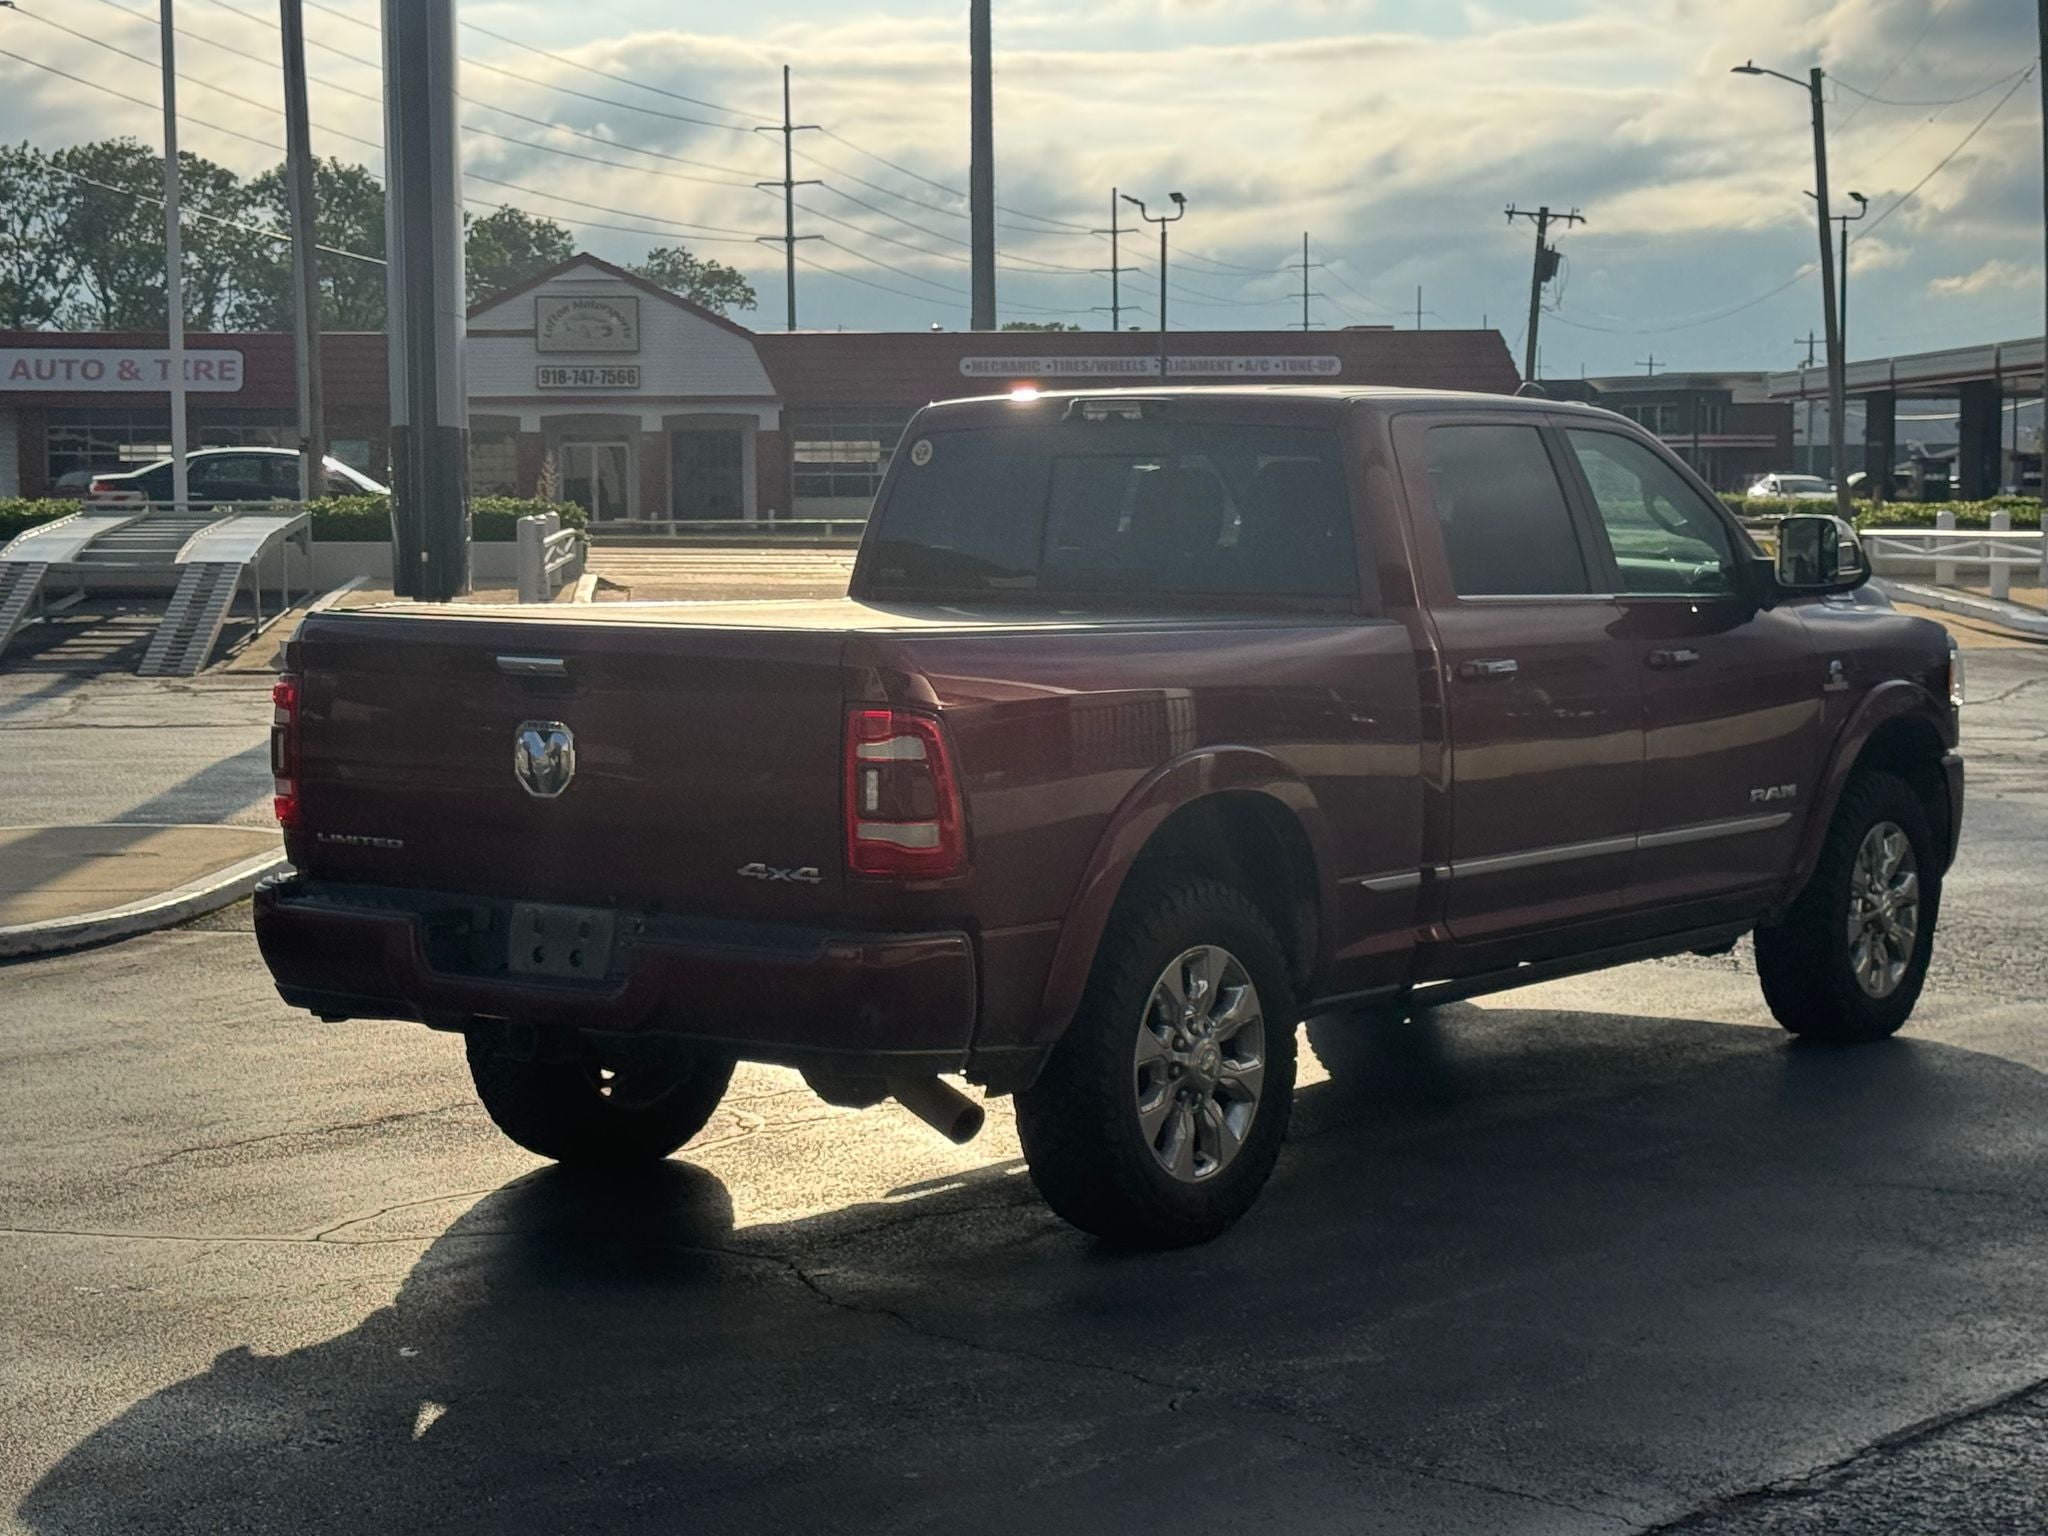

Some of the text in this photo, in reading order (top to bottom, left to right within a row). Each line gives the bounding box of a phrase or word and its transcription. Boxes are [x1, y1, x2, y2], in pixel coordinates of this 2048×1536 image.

[8, 358, 106, 381] AUTO
[117, 358, 144, 382] &
[971, 359, 1336, 374] MECHANIC TIRES/WHEELS LIGNMENT A/C TUNE-UP
[541, 368, 636, 385] 918-747-7566
[1749, 784, 1797, 802] RAM
[316, 832, 404, 849] LIMITED
